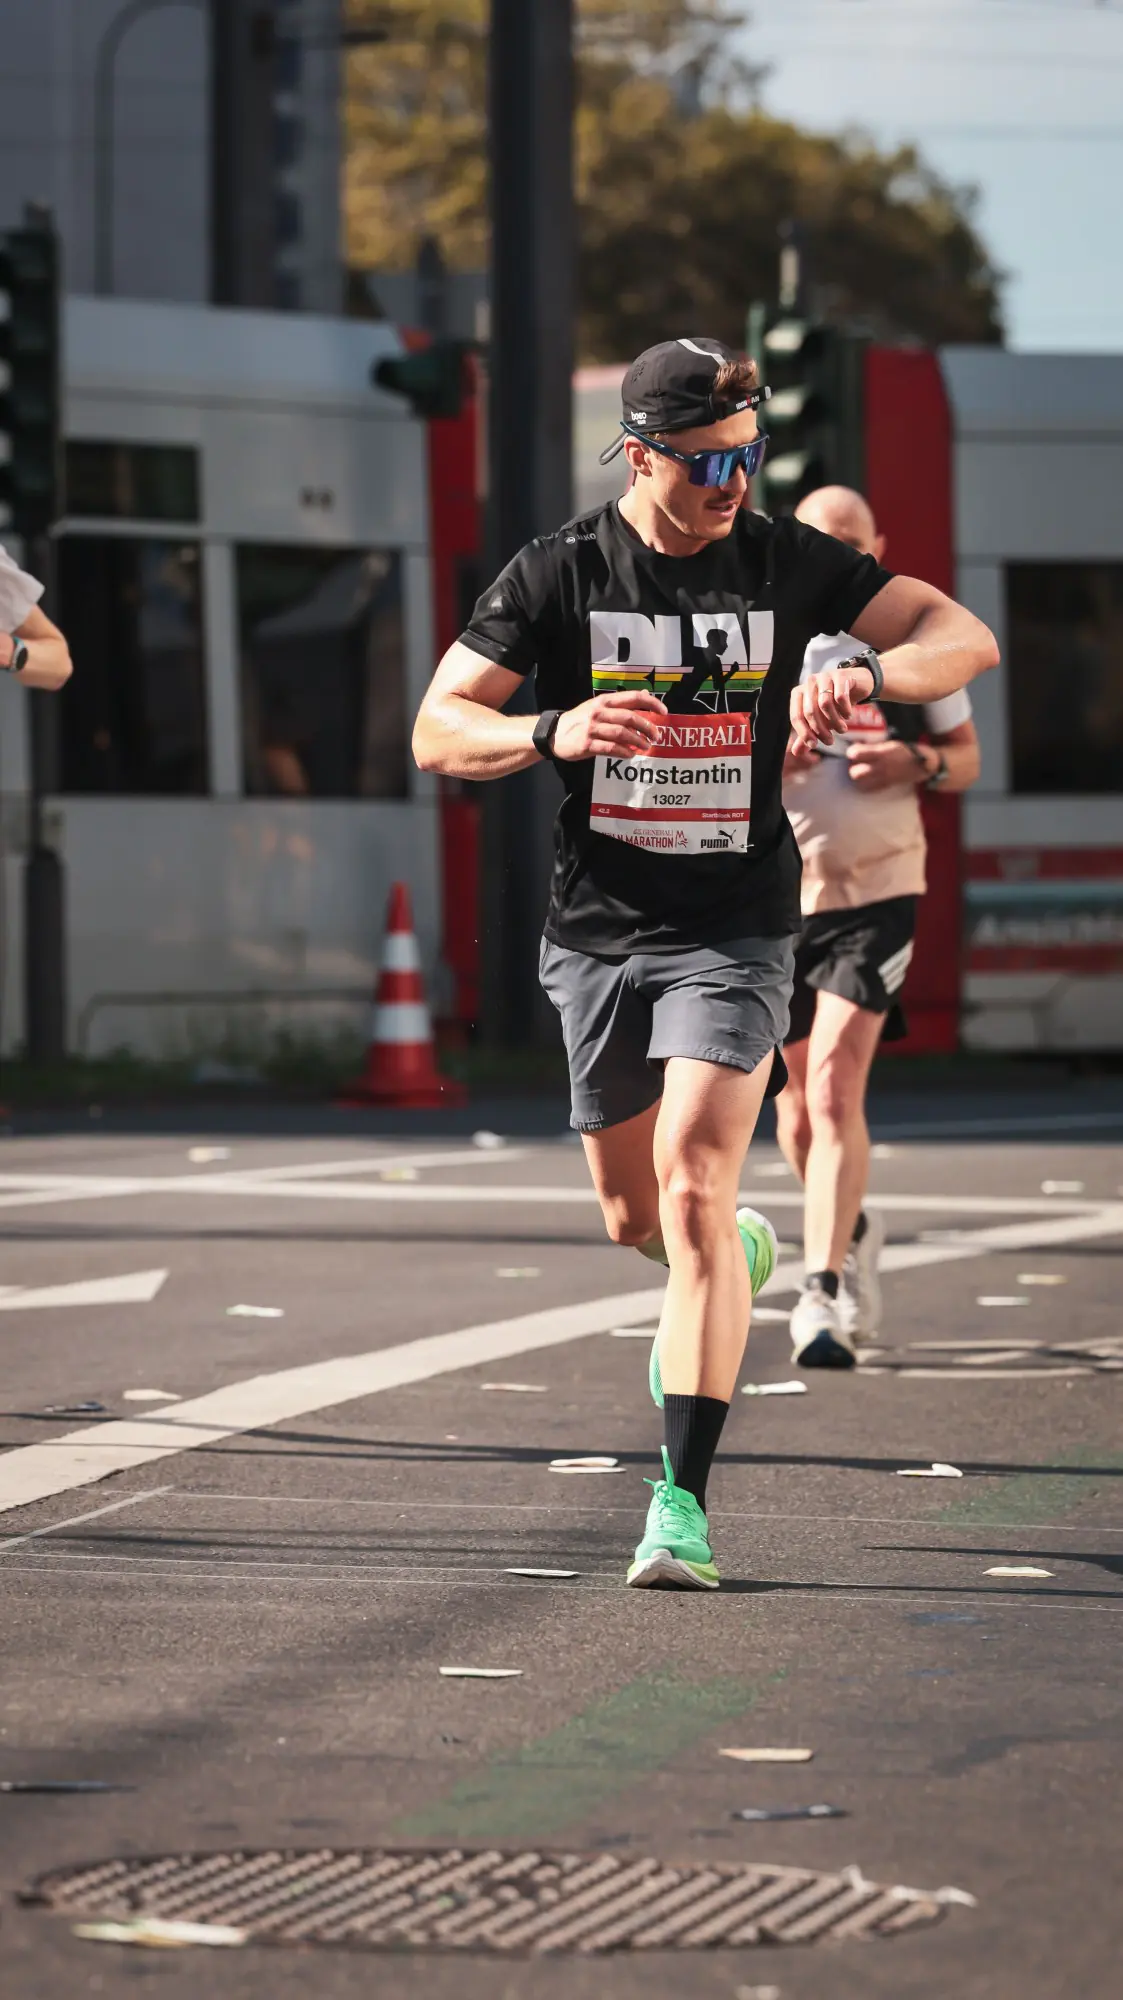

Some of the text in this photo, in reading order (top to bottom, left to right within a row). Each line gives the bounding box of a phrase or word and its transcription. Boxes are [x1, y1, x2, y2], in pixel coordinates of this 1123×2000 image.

[637, 724, 748, 749] ENERALI
[605, 757, 742, 785] Konstantin
[652, 794, 691, 805] 13027
[625, 835, 674, 849] MARATHON
[700, 838, 729, 849] PUMA
